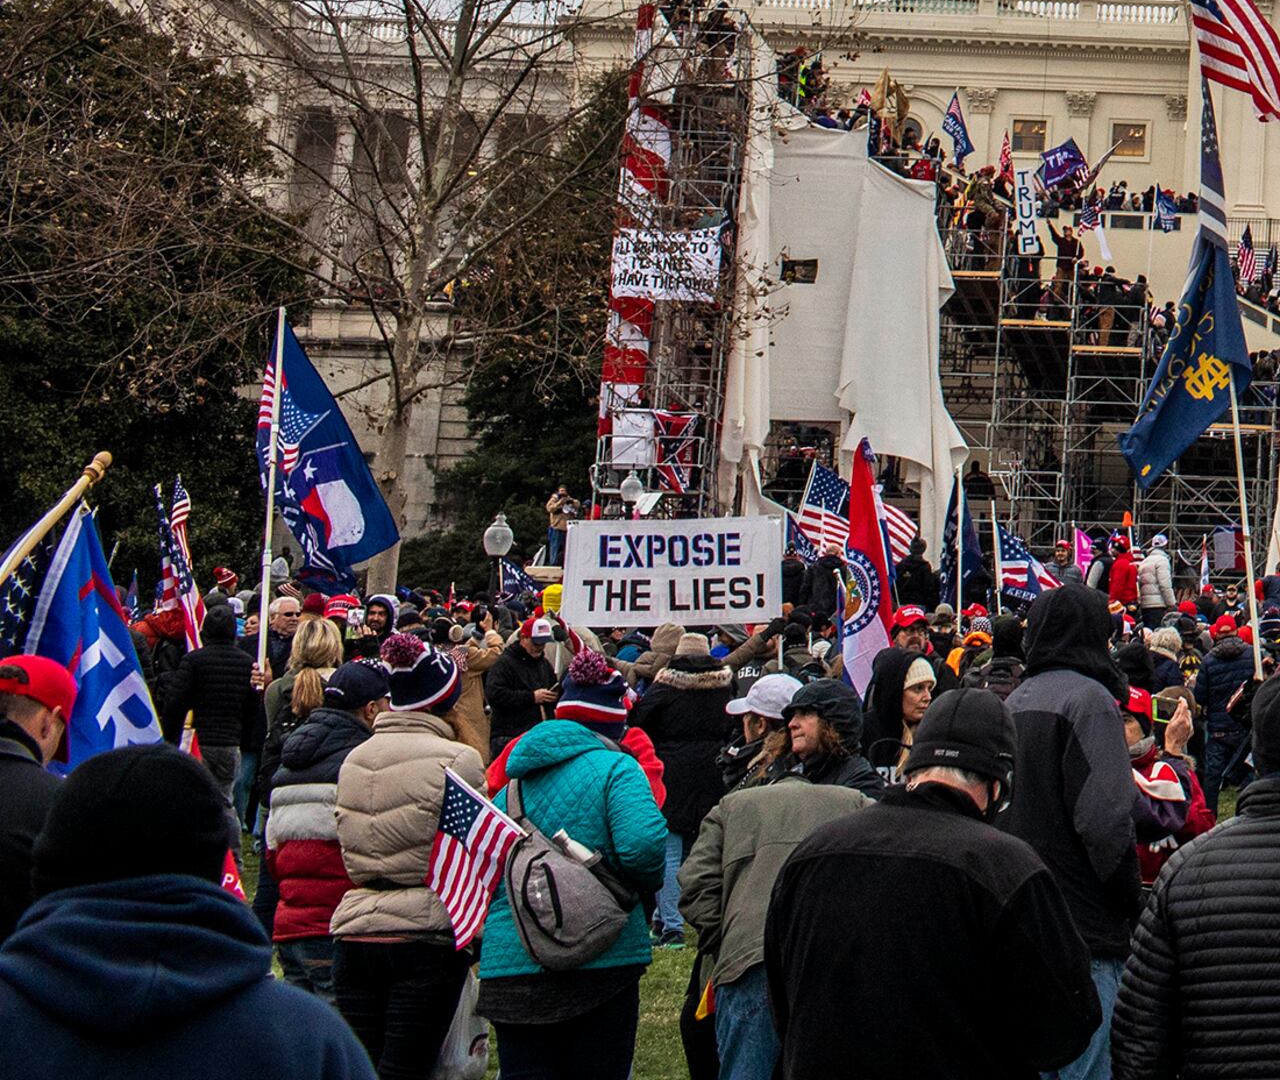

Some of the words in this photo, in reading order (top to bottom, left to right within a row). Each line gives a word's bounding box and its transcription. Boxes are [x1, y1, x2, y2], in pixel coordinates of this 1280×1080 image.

[1017, 170, 1038, 253] TRUMP
[690, 242, 709, 254] TO
[599, 532, 741, 569] EXPOSE
[582, 579, 651, 612] THE
[668, 573, 765, 612] LIES!
[1006, 587, 1038, 601] KEEP
